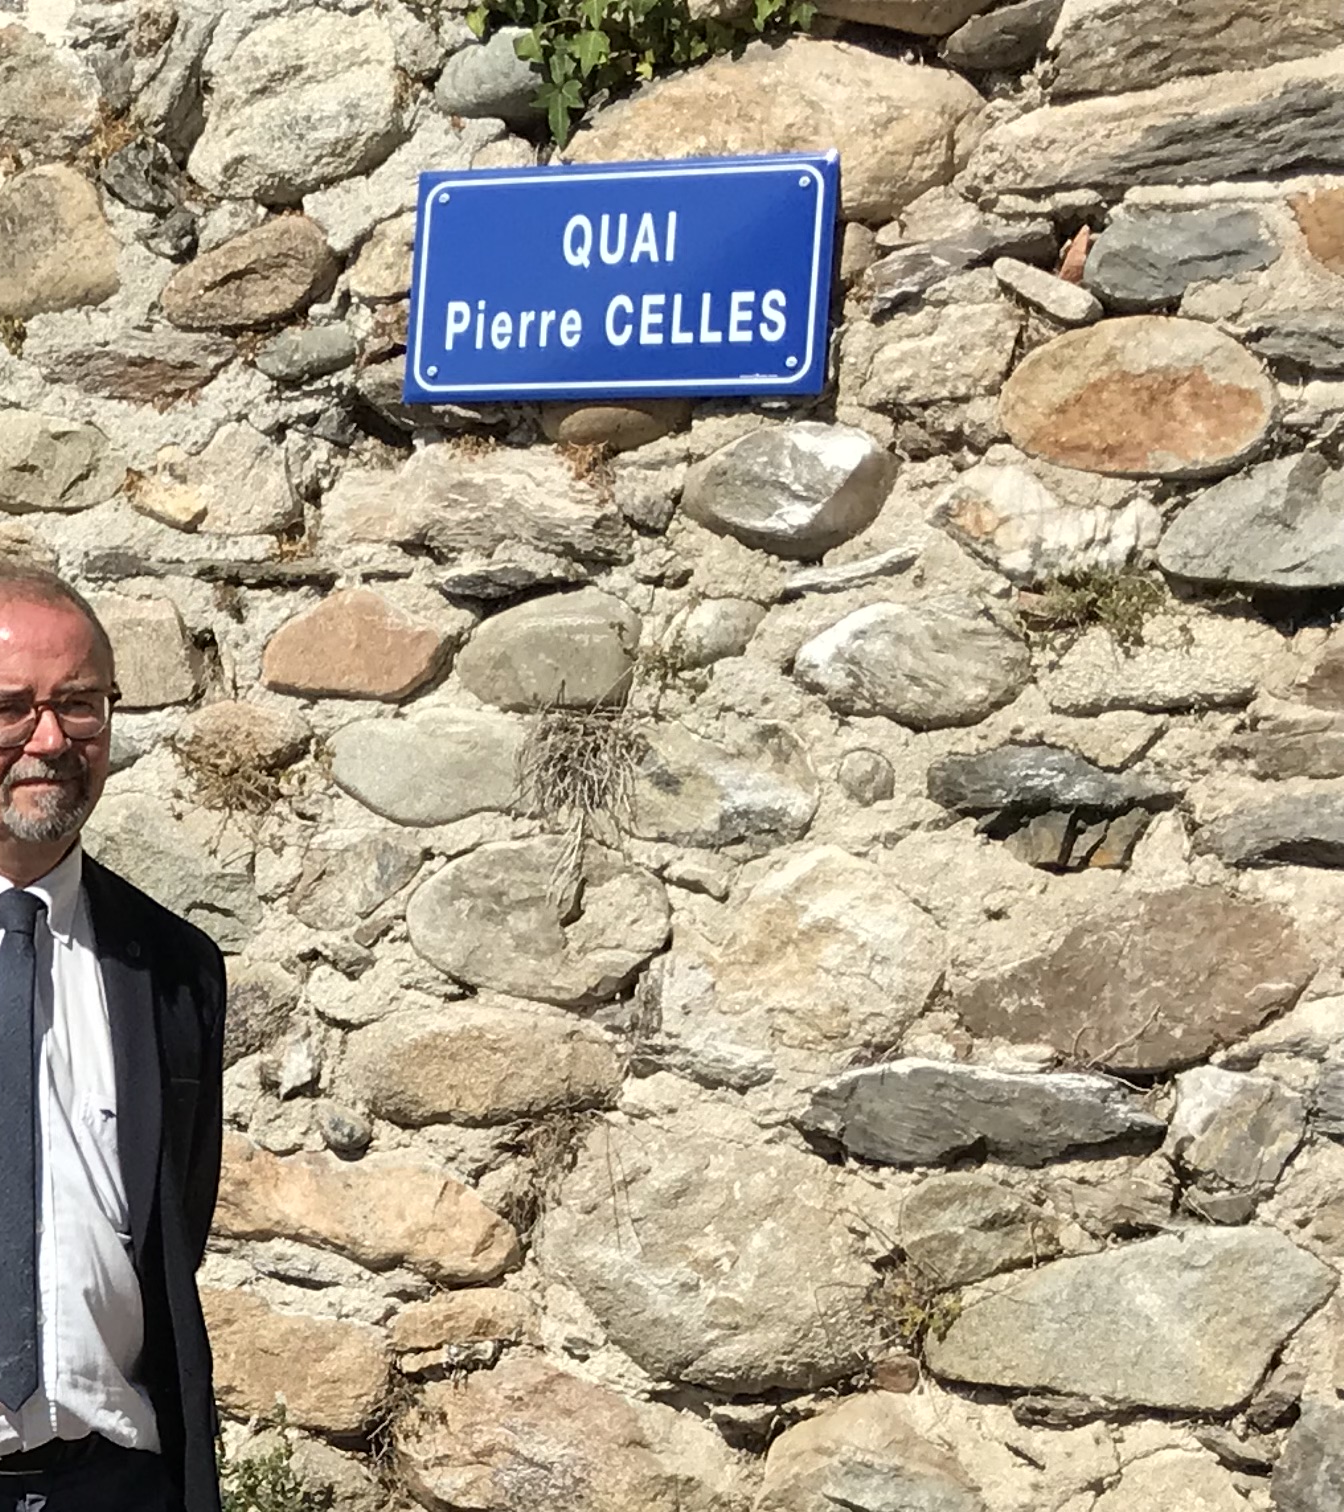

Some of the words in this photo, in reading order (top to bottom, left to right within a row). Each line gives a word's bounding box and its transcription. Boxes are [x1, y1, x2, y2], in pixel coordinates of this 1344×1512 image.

[562, 211, 677, 268] QUAI
[445, 300, 582, 351] Pierre
[605, 289, 787, 346] CELLES
